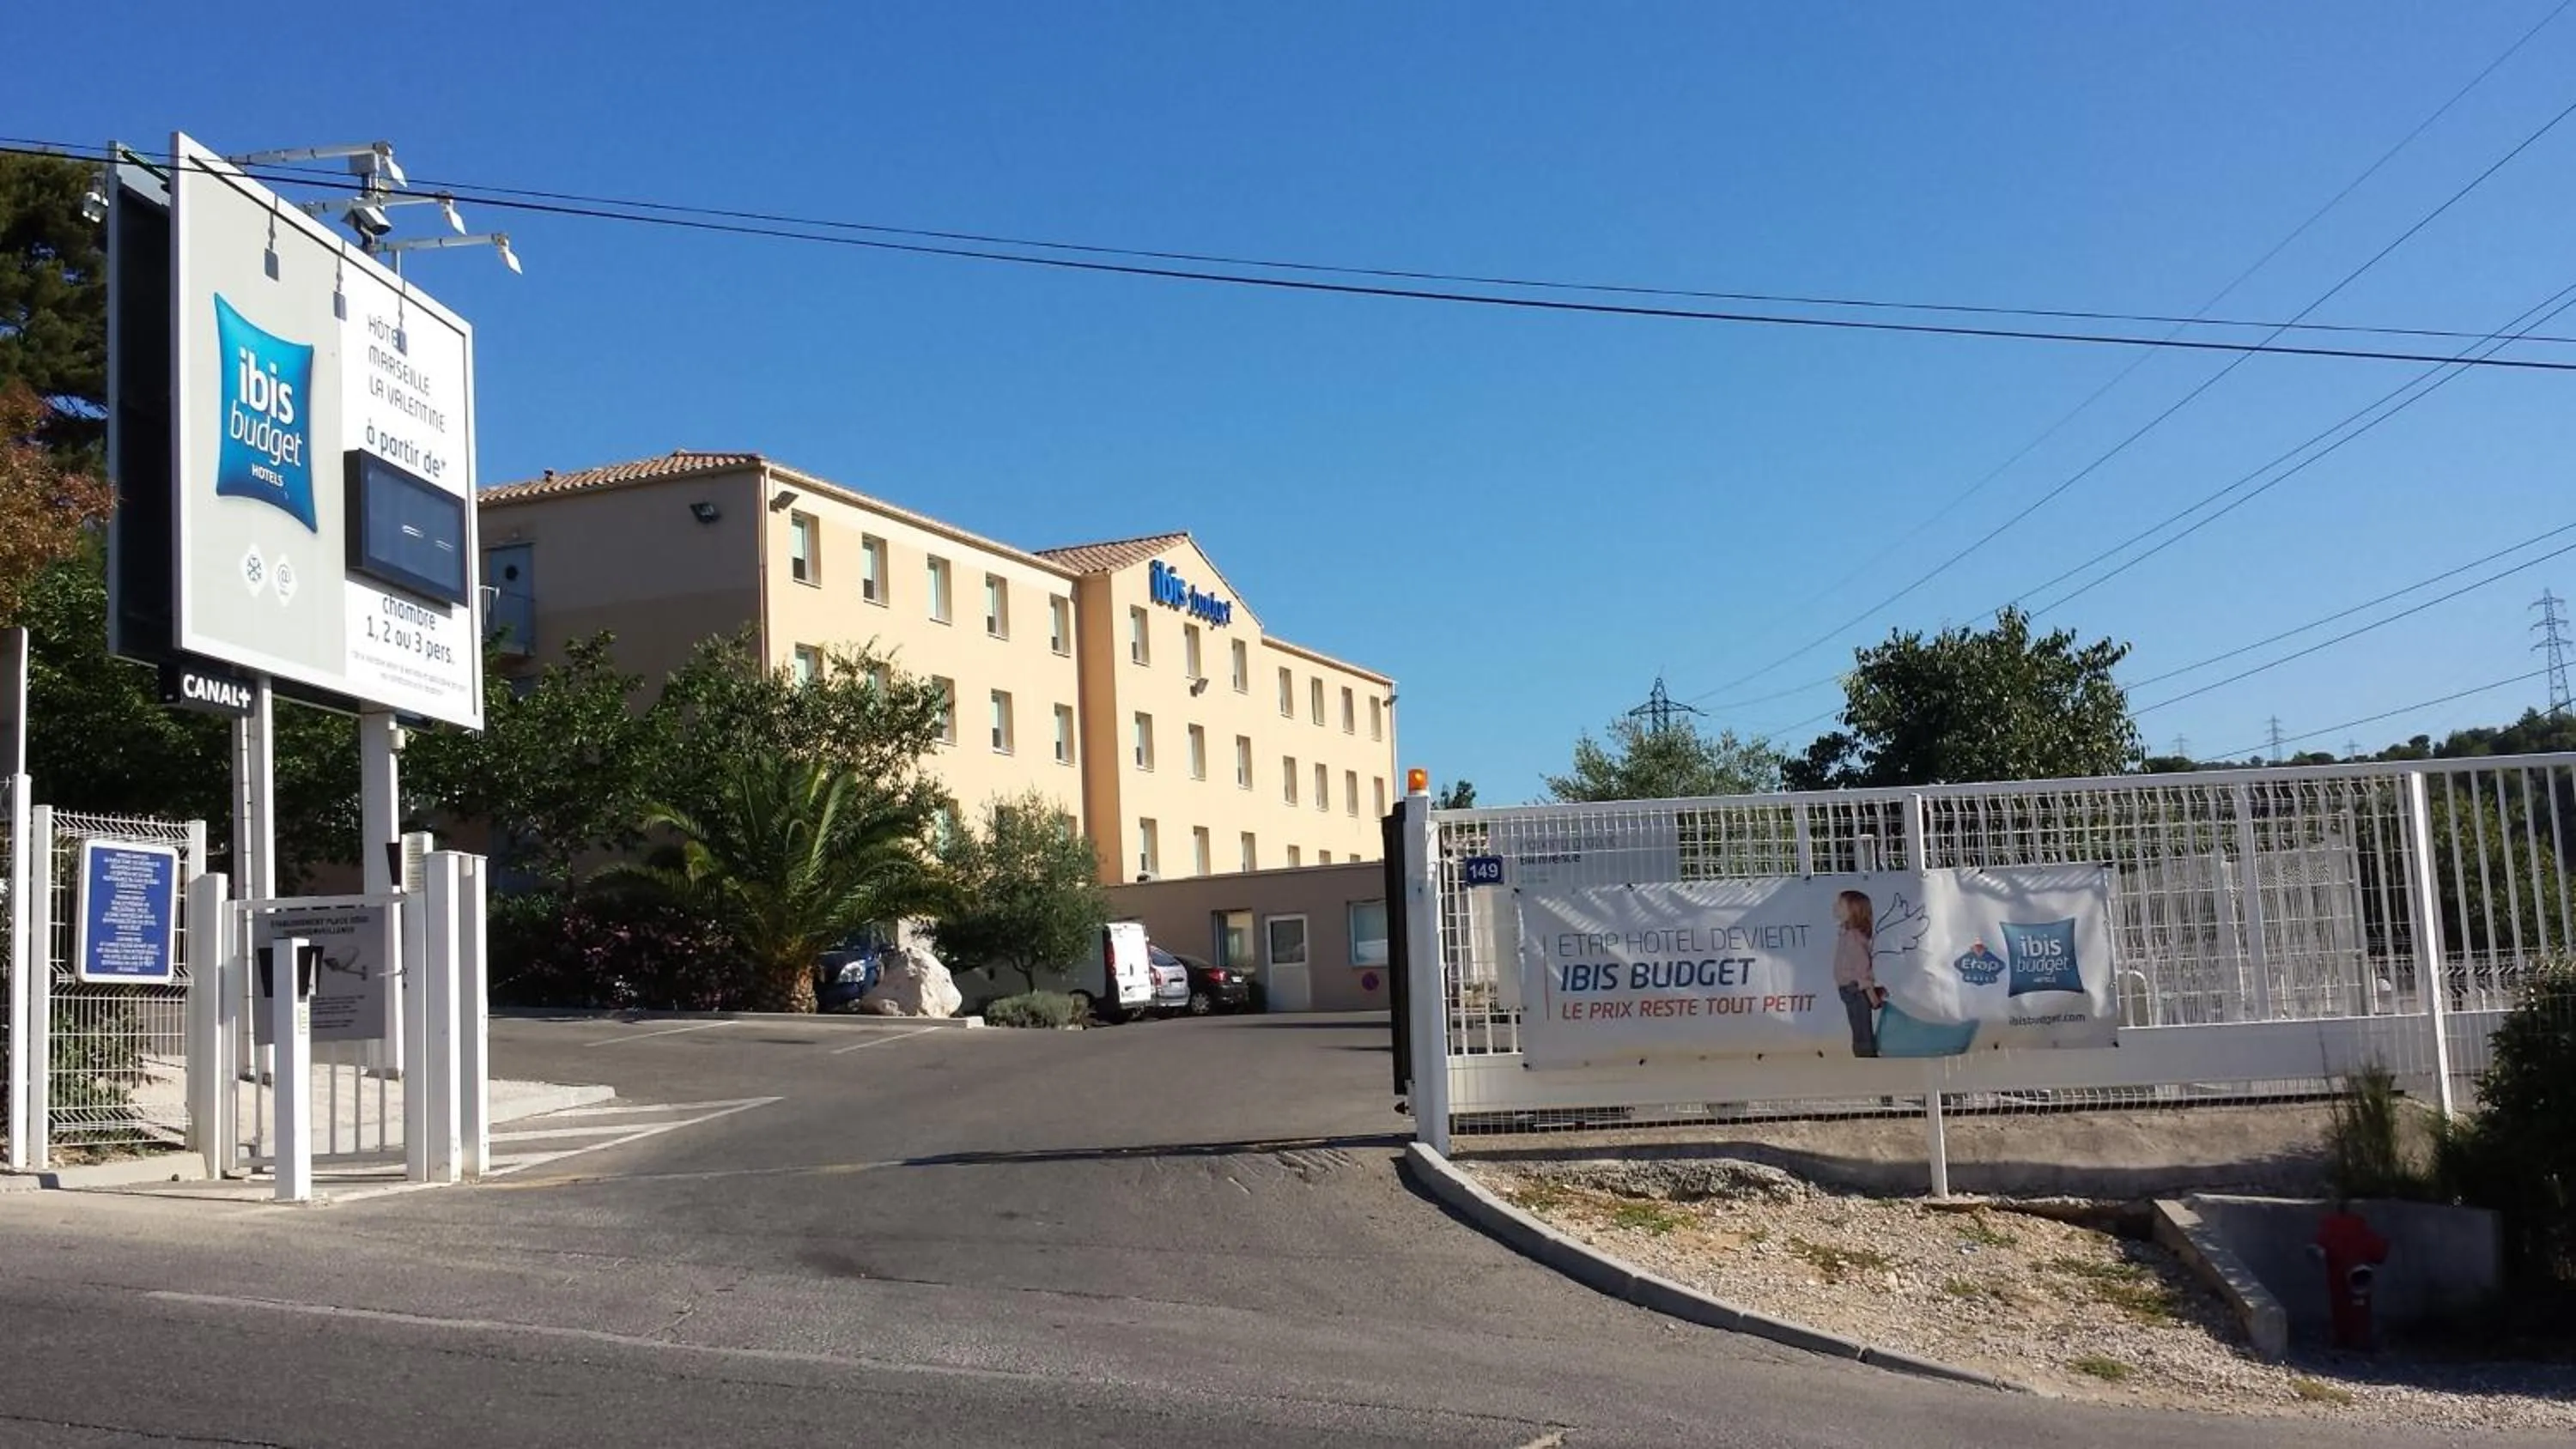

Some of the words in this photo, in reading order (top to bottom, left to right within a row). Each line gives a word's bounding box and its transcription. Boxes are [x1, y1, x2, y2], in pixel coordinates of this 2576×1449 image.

[239, 346, 295, 425] ibis
[368, 345, 429, 396] MARSEILLE
[369, 374, 384, 398] LA
[387, 385, 446, 433] VALENTINE
[231, 399, 303, 467] budget
[380, 432, 419, 467] partir
[252, 464, 284, 487] HOTELS
[382, 593, 436, 630] chambre
[383, 621, 391, 643] 2
[395, 629, 411, 650] ou
[415, 632, 422, 652] 3
[183, 674, 252, 708] CANAL+
[1468, 863, 1498, 879] 149
[1558, 932, 1619, 957] ETAP
[1625, 928, 1704, 955] HOTEL
[1711, 925, 1810, 951] DEVIENT
[2020, 934, 2061, 957] ibis
[1560, 963, 1619, 991] IBIS
[1630, 958, 1756, 990] BUDGET
[1961, 957, 2000, 973] Etap
[2018, 955, 2069, 975] budget
[1562, 1003, 1582, 1020] LE
[1589, 1002, 1632, 1019] PRIX
[1639, 998, 1698, 1017] RESTE
[1706, 997, 1758, 1016] TOUT
[1763, 994, 1816, 1013] PETIT
[2009, 1013, 2086, 1026] ibisbudget.com
